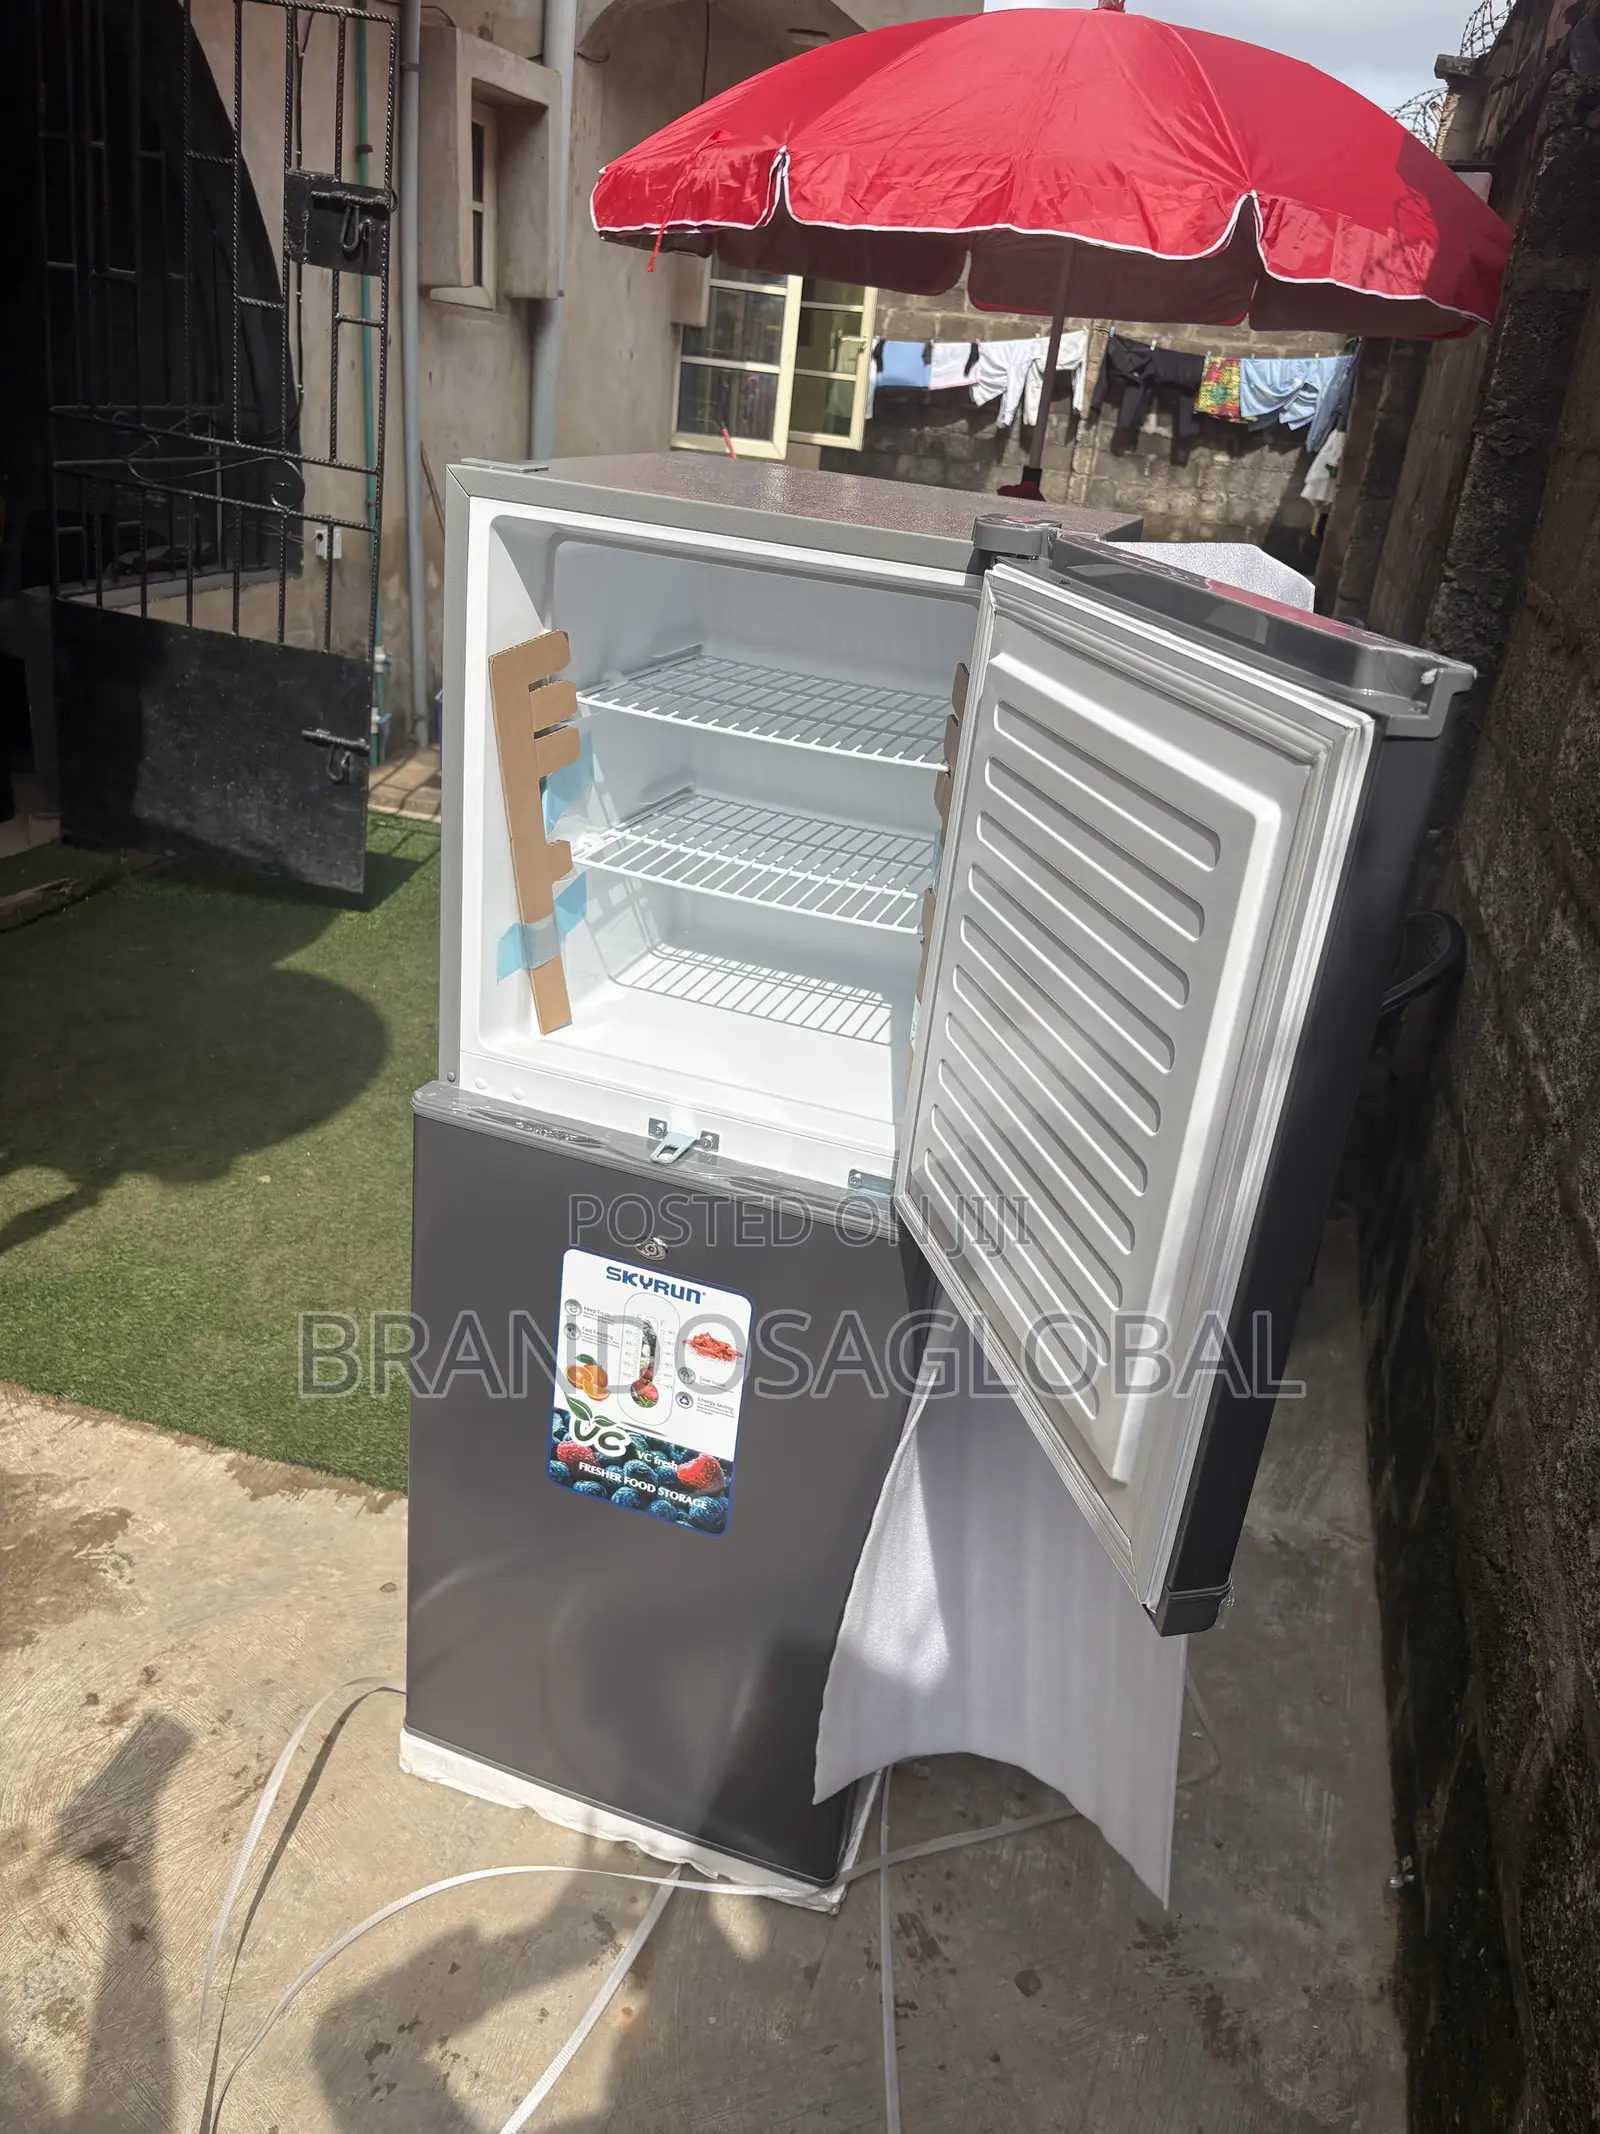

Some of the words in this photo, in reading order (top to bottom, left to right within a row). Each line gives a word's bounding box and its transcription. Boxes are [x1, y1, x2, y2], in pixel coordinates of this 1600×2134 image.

[605, 1265, 702, 1305] SKYRUN
[636, 1450, 653, 1463] VC
[653, 1455, 678, 1471] fresh
[578, 1461, 623, 1483] FRESHER
[622, 1476, 657, 1494] FOOD
[656, 1486, 708, 1510] STORAGE
